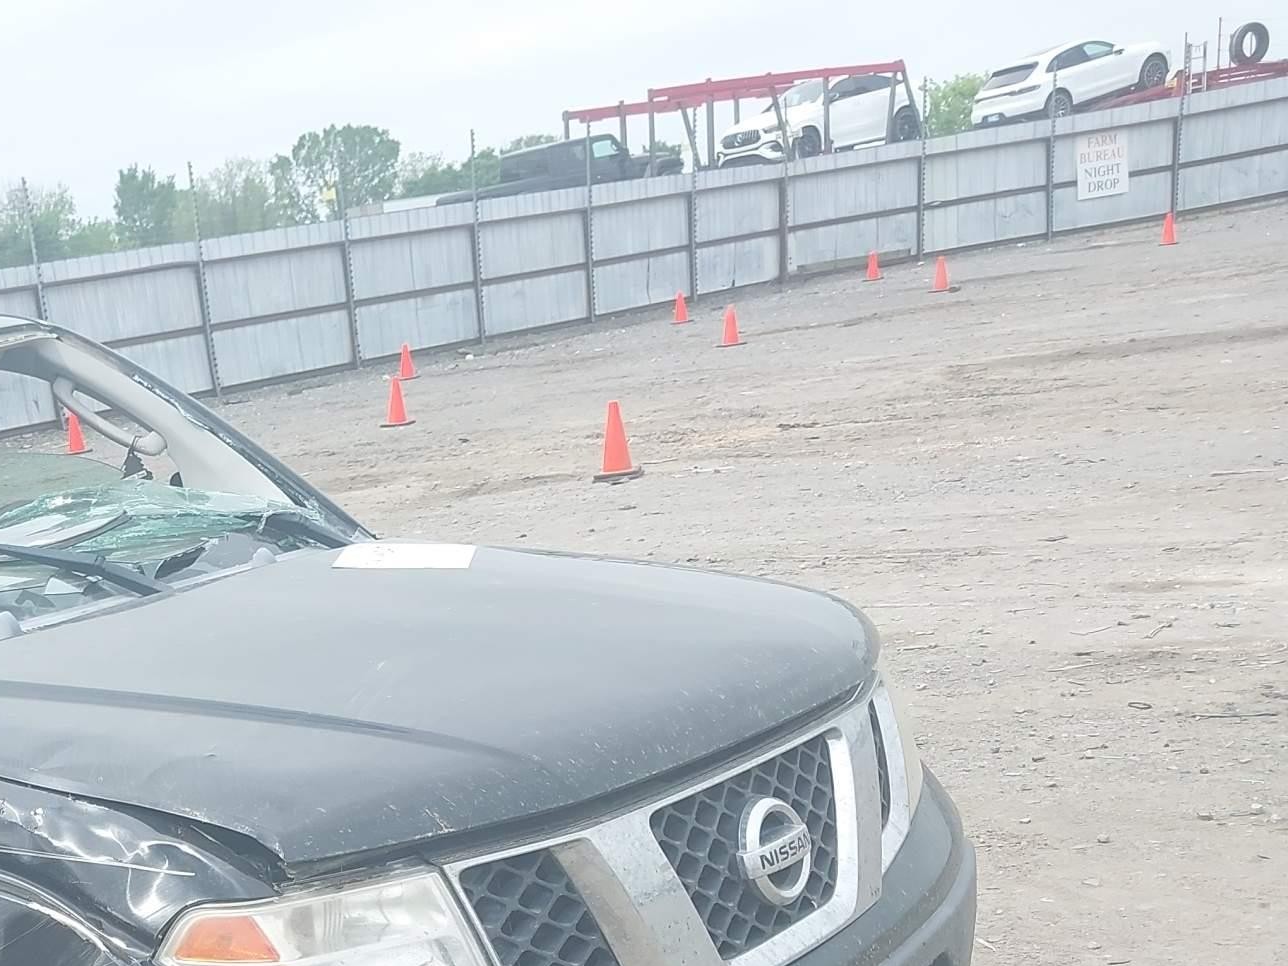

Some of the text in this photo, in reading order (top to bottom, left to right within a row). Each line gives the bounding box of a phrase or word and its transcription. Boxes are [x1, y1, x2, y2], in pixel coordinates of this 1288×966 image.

[1088, 134, 1118, 148] FARM
[1079, 147, 1125, 164] BUREAU
[1084, 163, 1121, 178] NIGHT
[1088, 178, 1120, 193] DROP
[760, 830, 810, 870] NISSAN
